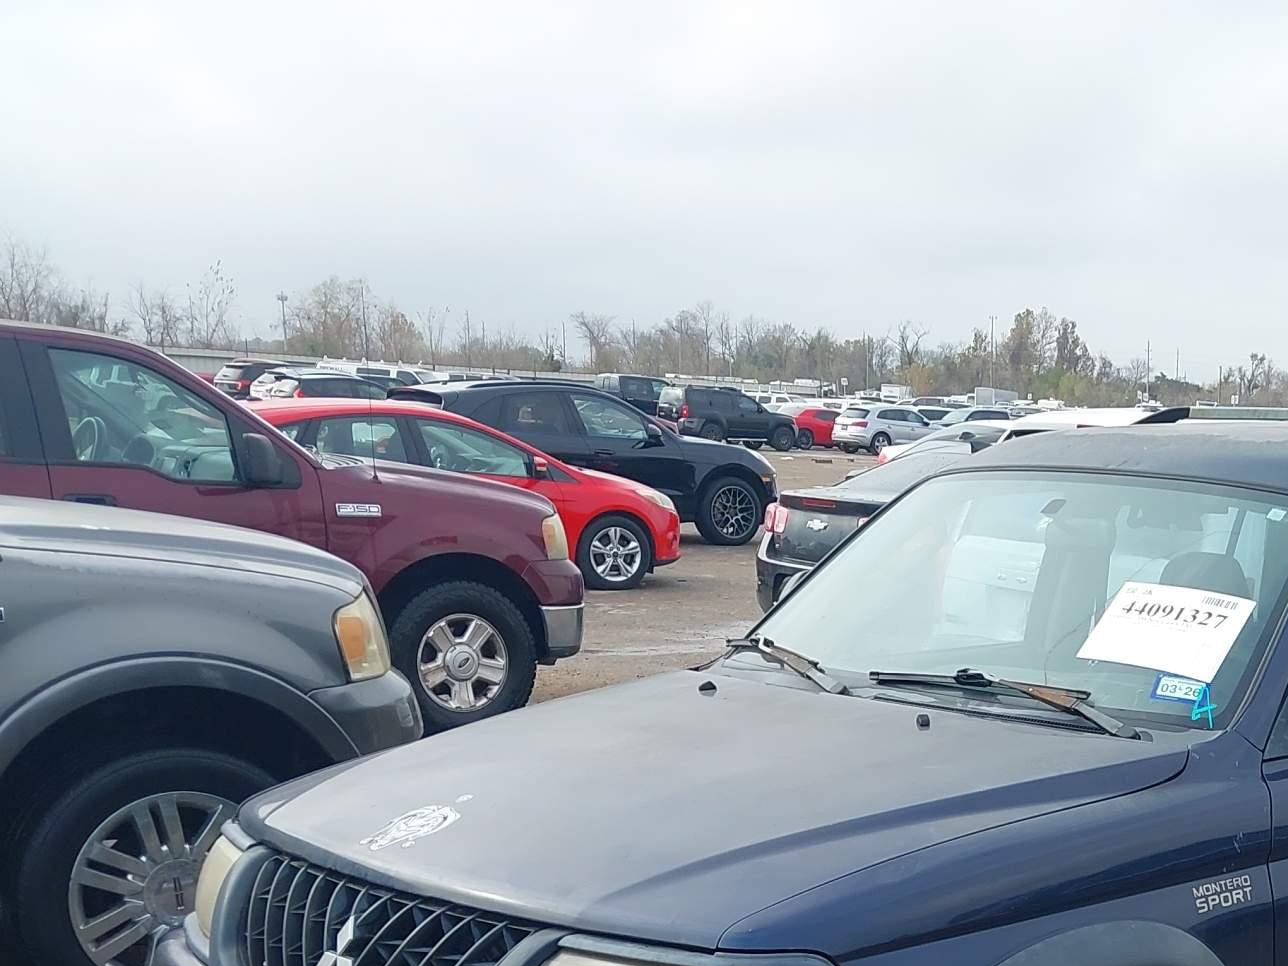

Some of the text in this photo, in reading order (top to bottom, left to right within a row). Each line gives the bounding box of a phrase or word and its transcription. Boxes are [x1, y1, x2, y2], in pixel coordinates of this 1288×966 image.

[1121, 600, 1229, 629] 44091327
[1192, 875, 1251, 898] MONTERO
[1195, 887, 1252, 913] SPORT
